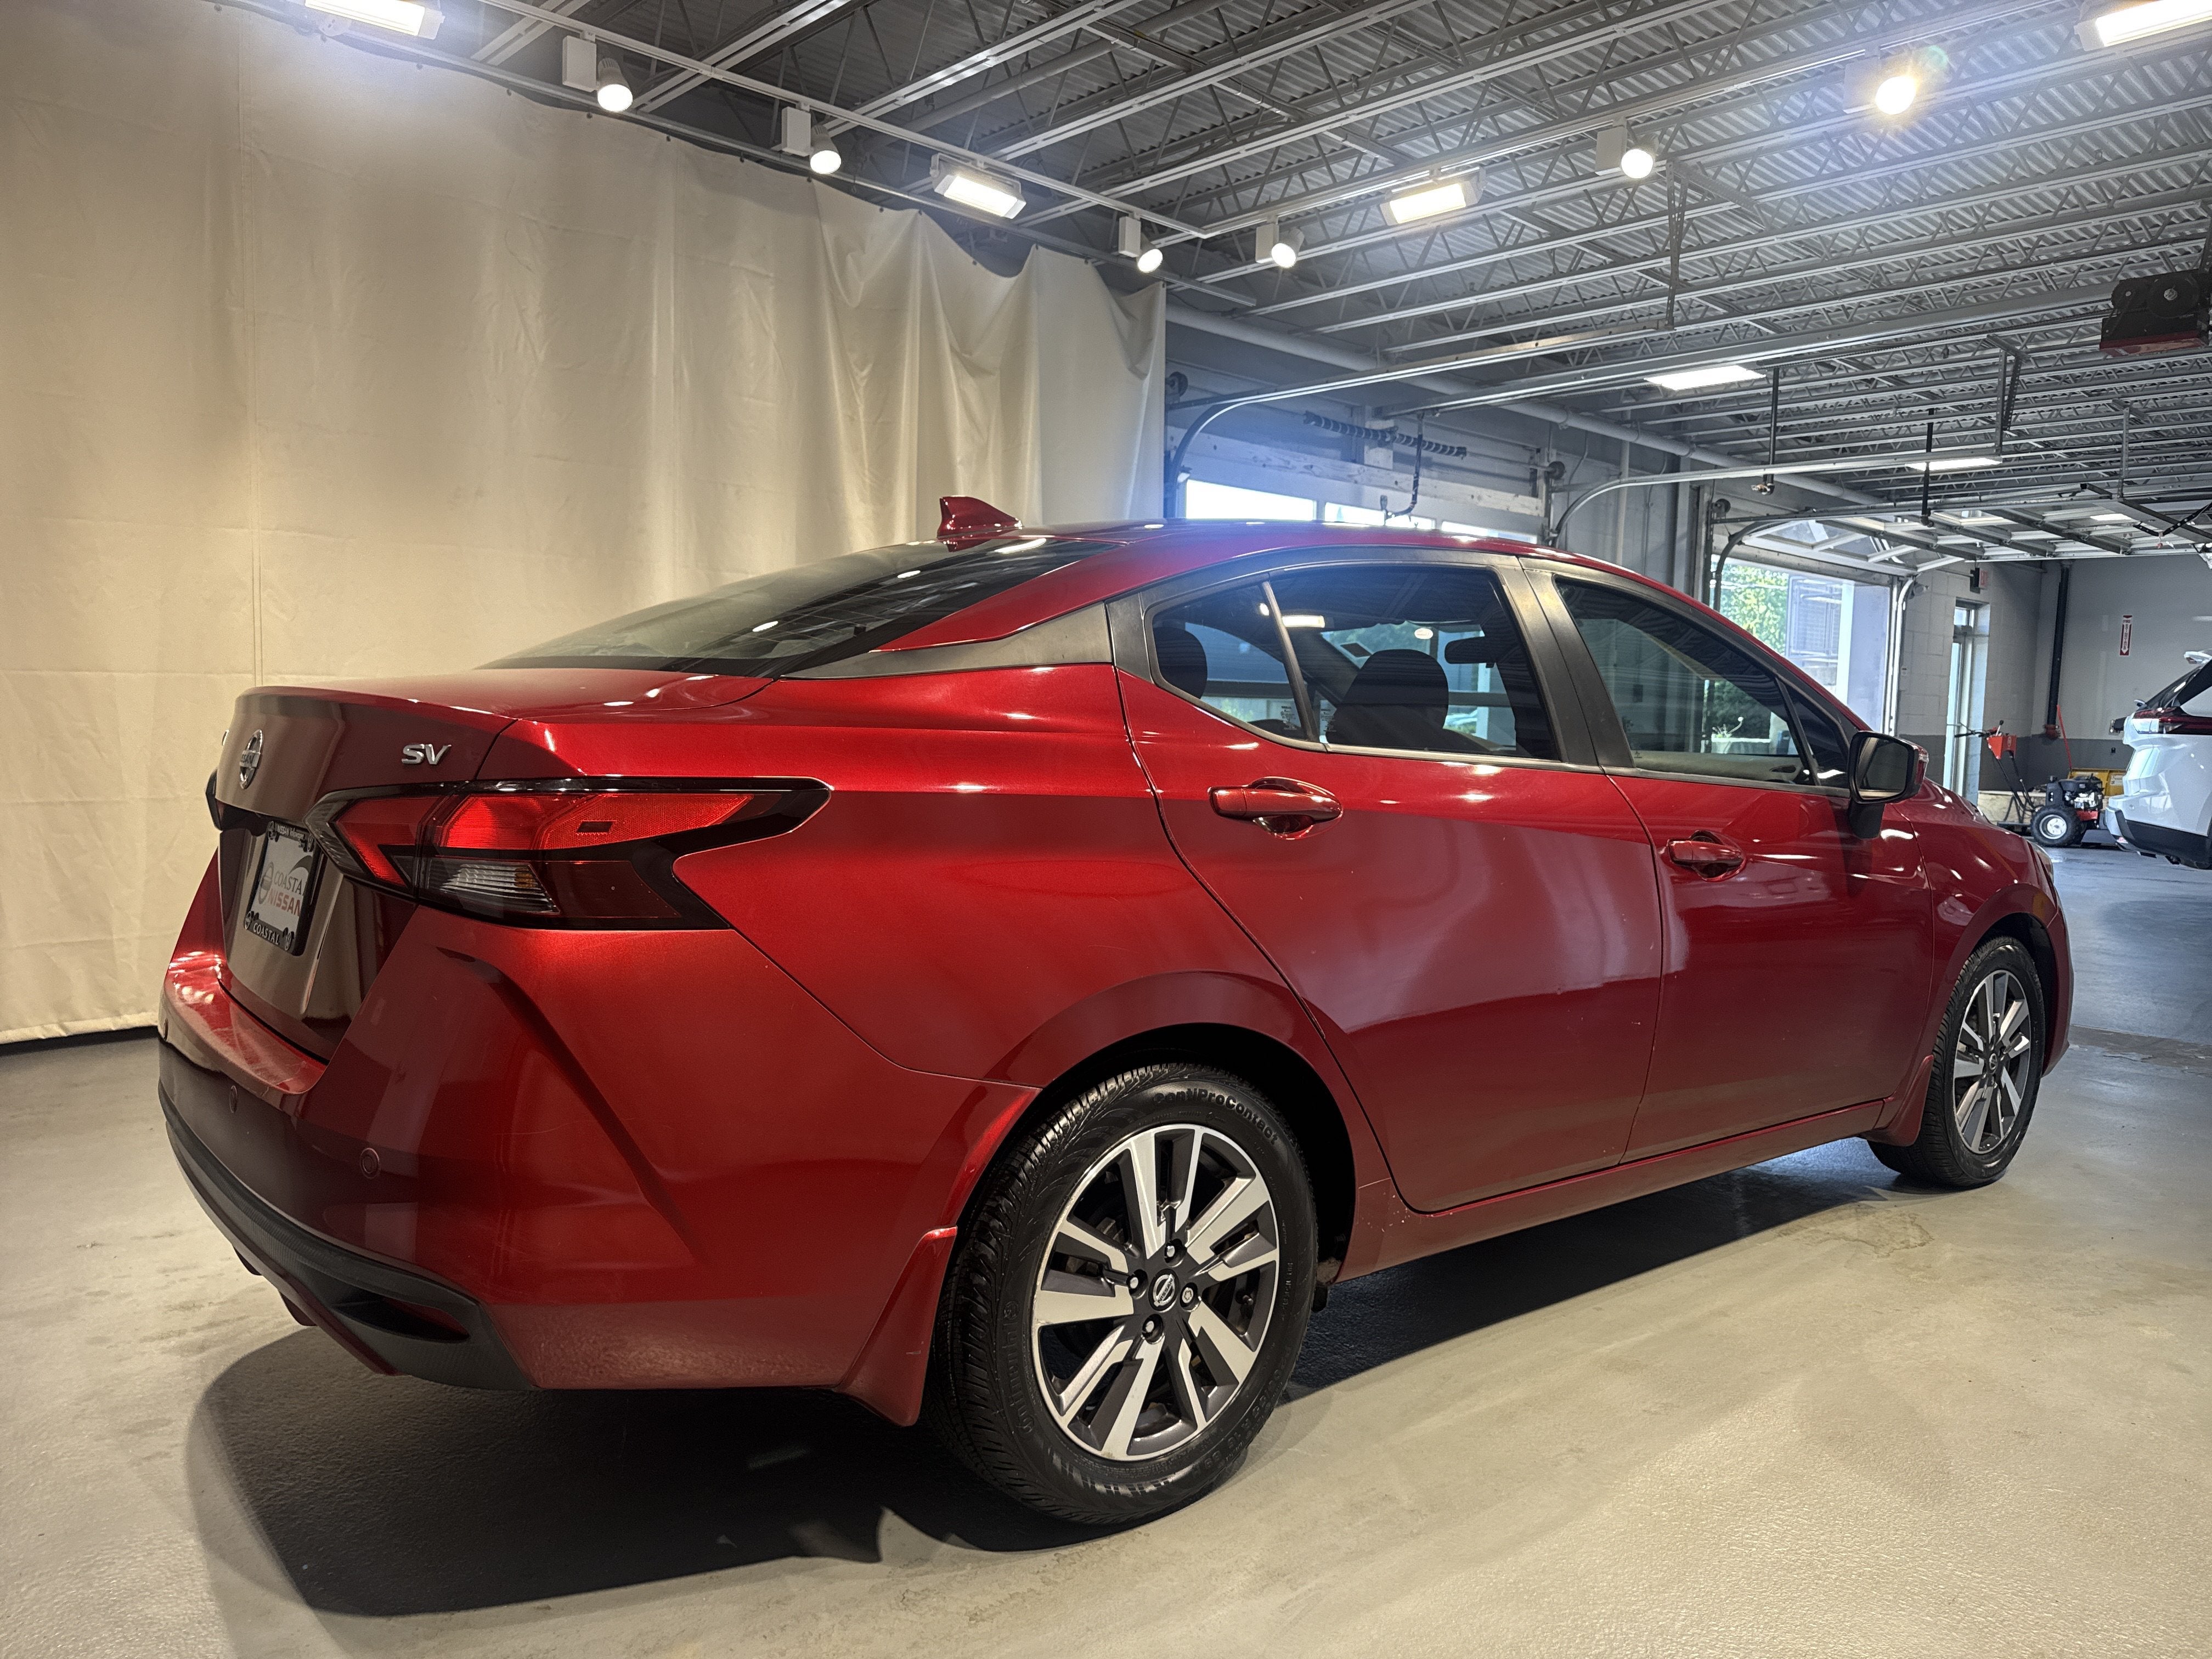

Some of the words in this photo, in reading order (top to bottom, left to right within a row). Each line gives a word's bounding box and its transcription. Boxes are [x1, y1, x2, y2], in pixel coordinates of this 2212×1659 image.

[401, 743, 452, 765] SV
[274, 871, 304, 896] COASTA
[253, 922, 280, 946] COASTAL
[1156, 1278, 1173, 1304] NISSAN
